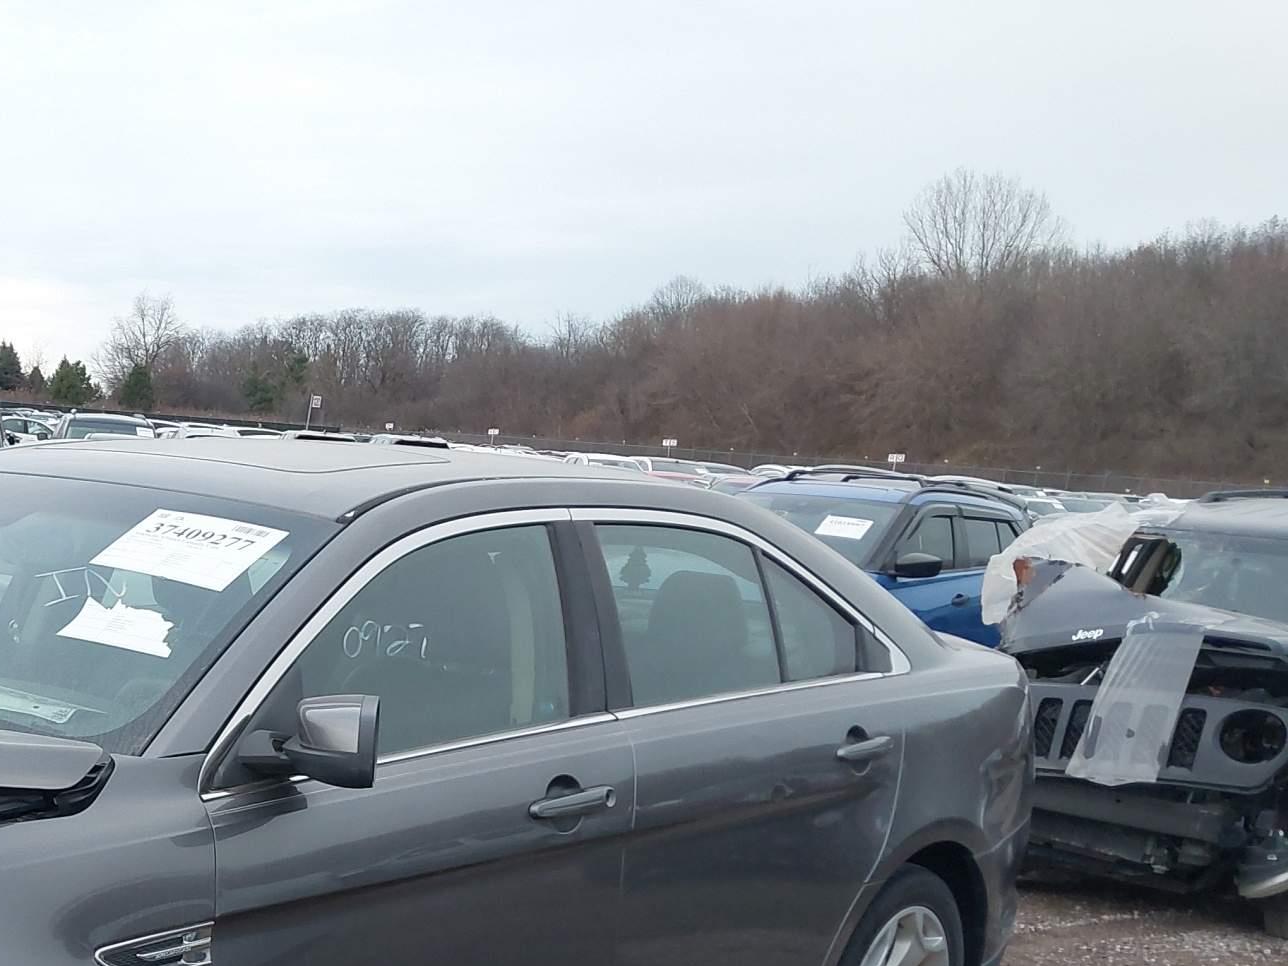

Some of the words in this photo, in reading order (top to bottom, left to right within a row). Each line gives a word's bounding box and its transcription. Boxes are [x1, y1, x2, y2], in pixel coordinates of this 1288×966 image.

[145, 522, 256, 550] 37409277
[343, 620, 427, 658] 0927
[1072, 629, 1104, 640] Jeep
